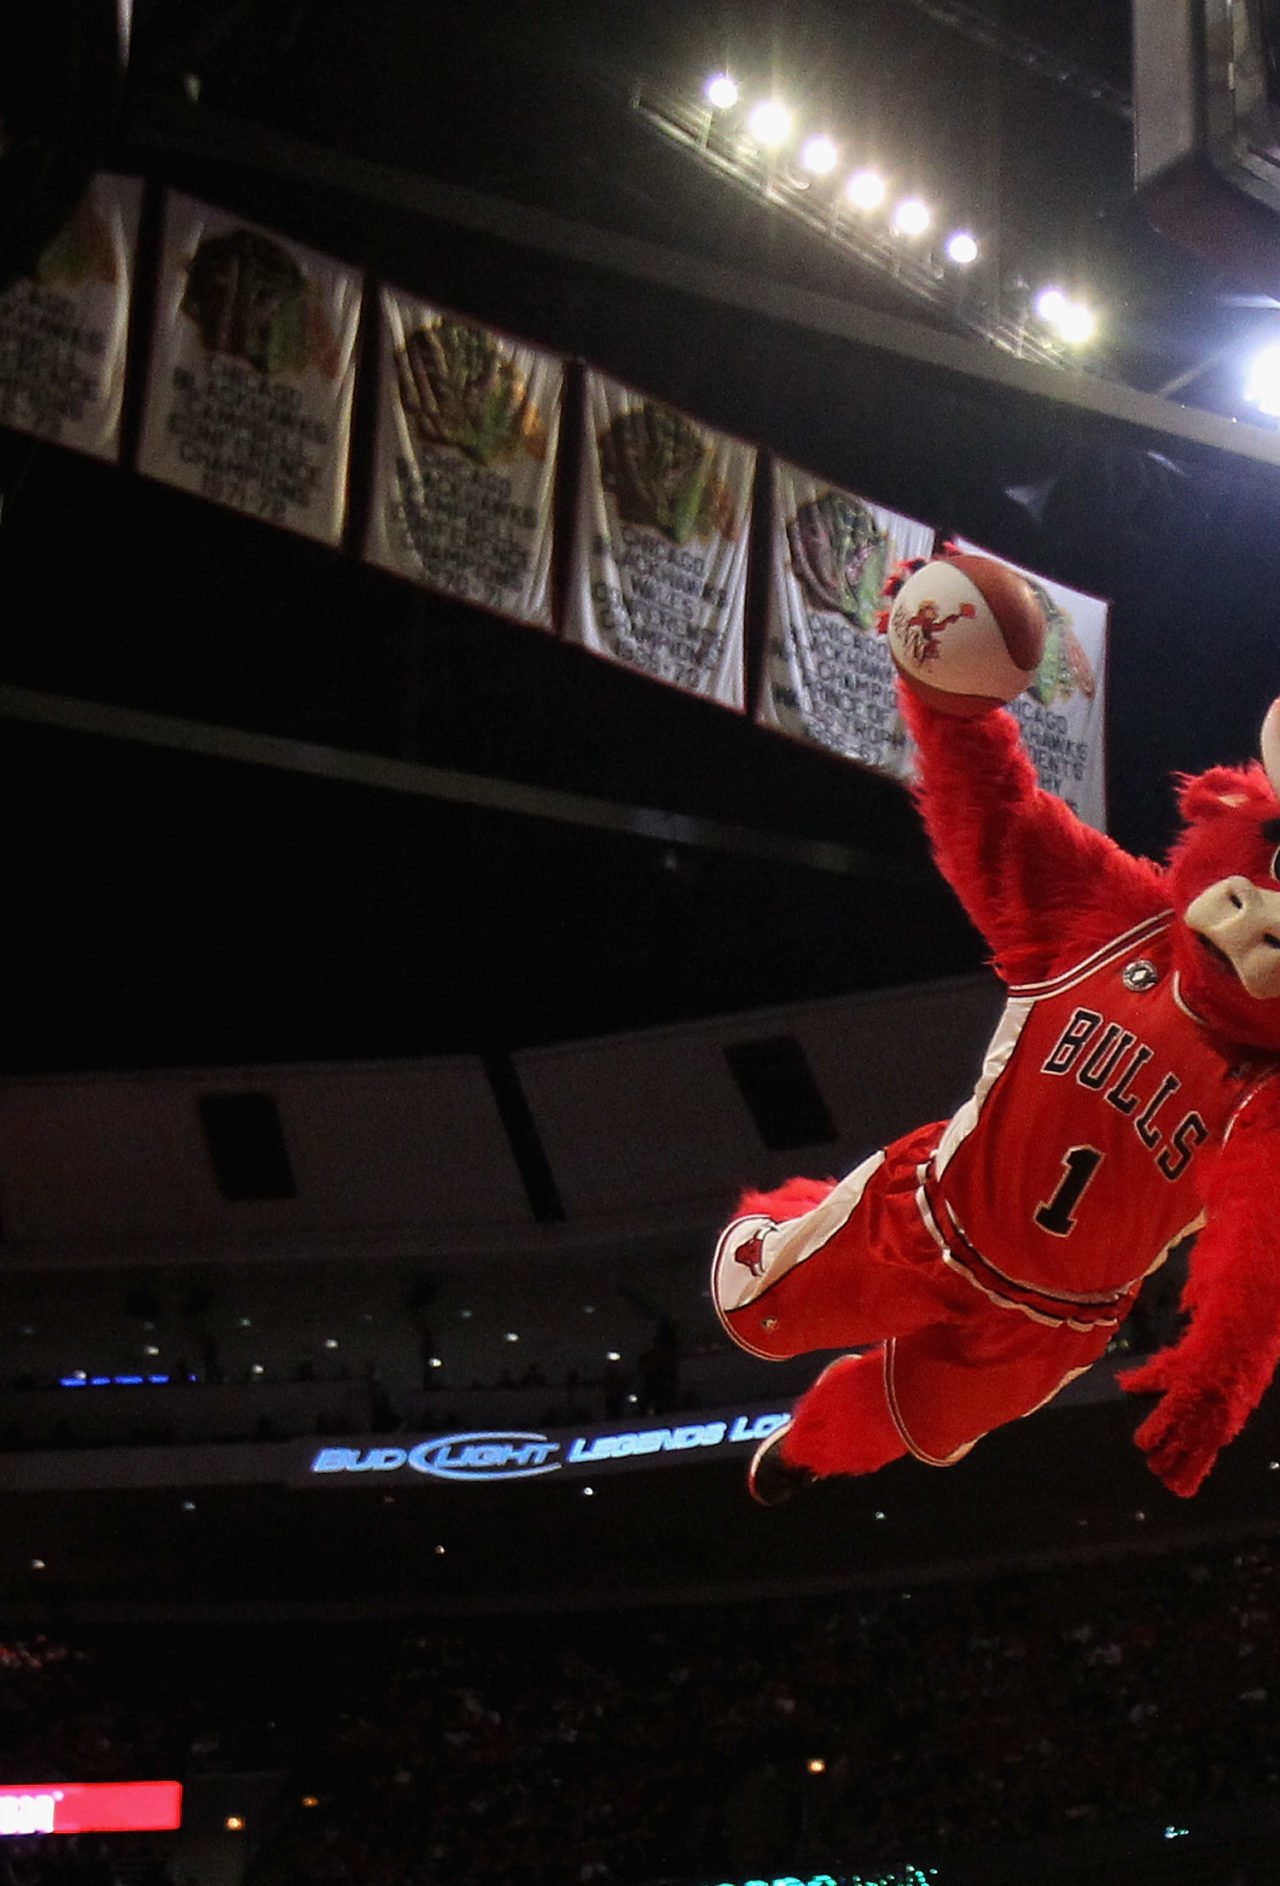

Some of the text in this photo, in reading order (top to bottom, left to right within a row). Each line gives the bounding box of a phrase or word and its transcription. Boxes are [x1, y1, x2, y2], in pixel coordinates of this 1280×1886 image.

[1040, 1006, 1209, 1183] BULLS
[1033, 1143, 1105, 1238] 1
[312, 1413, 793, 1473] BUD LIGHT LEGENDS LO
